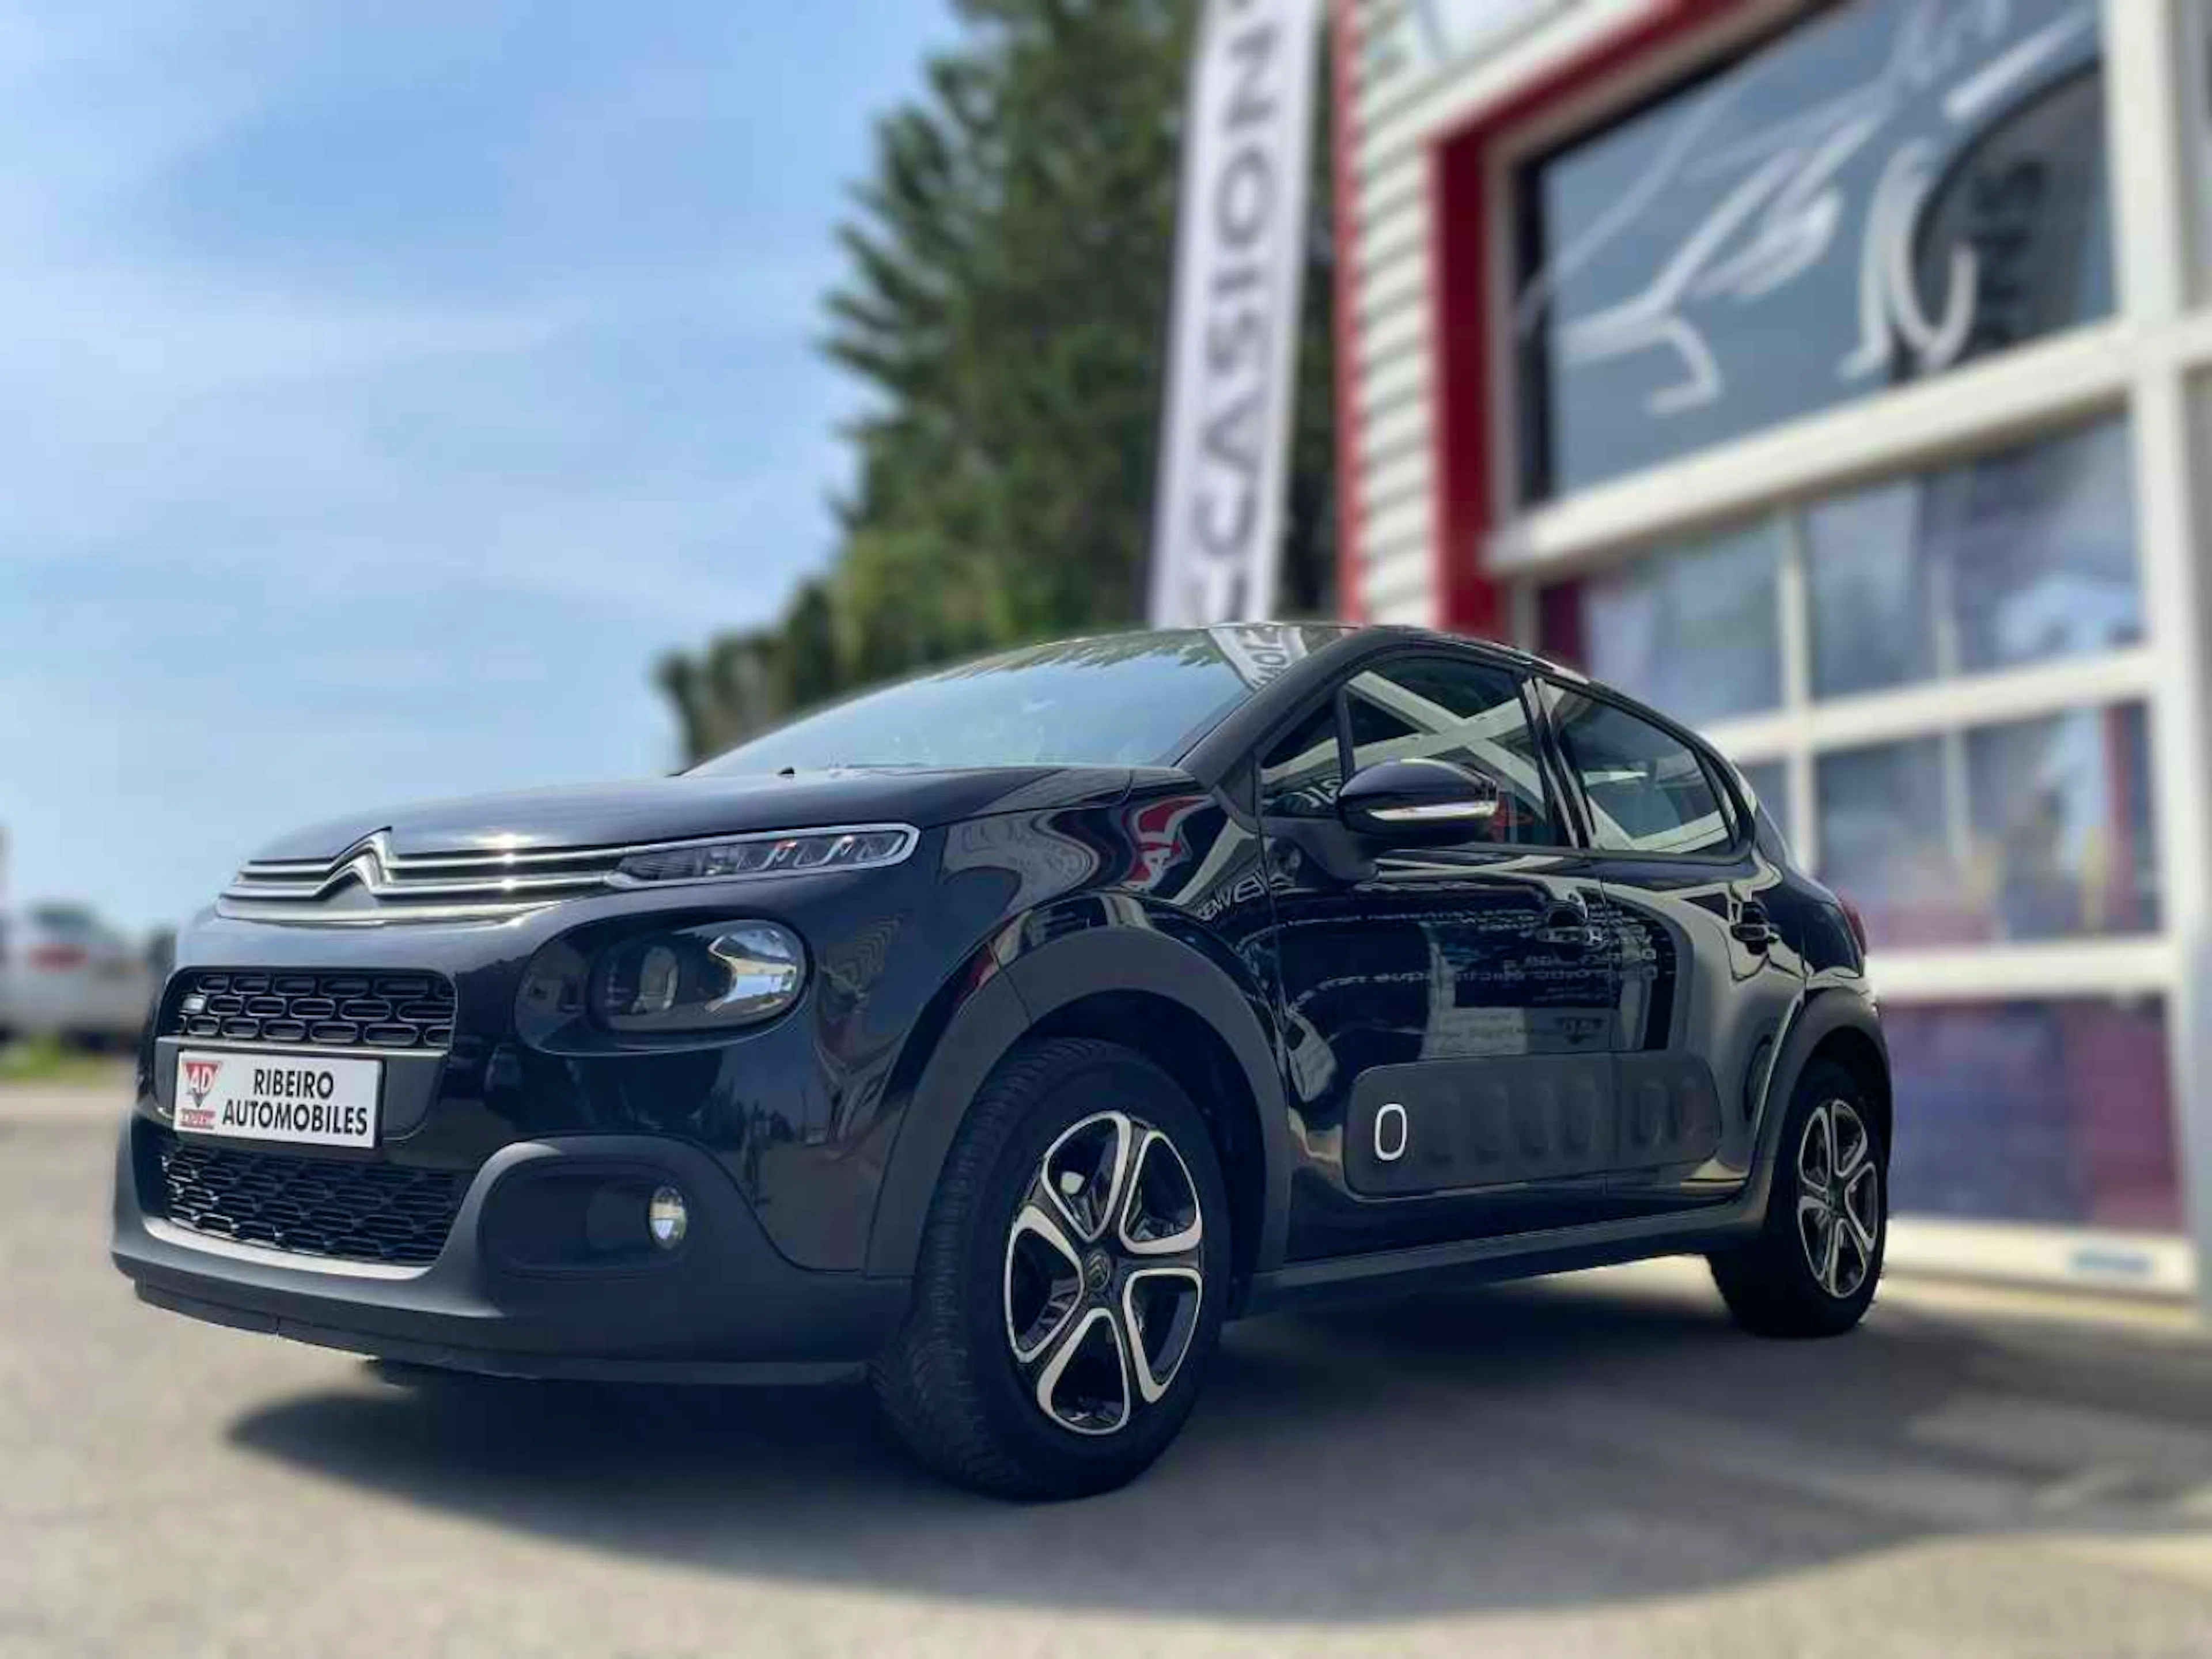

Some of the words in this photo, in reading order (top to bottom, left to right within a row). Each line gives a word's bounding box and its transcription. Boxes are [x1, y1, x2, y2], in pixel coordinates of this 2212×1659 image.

[189, 1065, 214, 1093] AD
[254, 1069, 334, 1100] RIBEIRO
[222, 1100, 368, 1136] AUTOMOBILES
